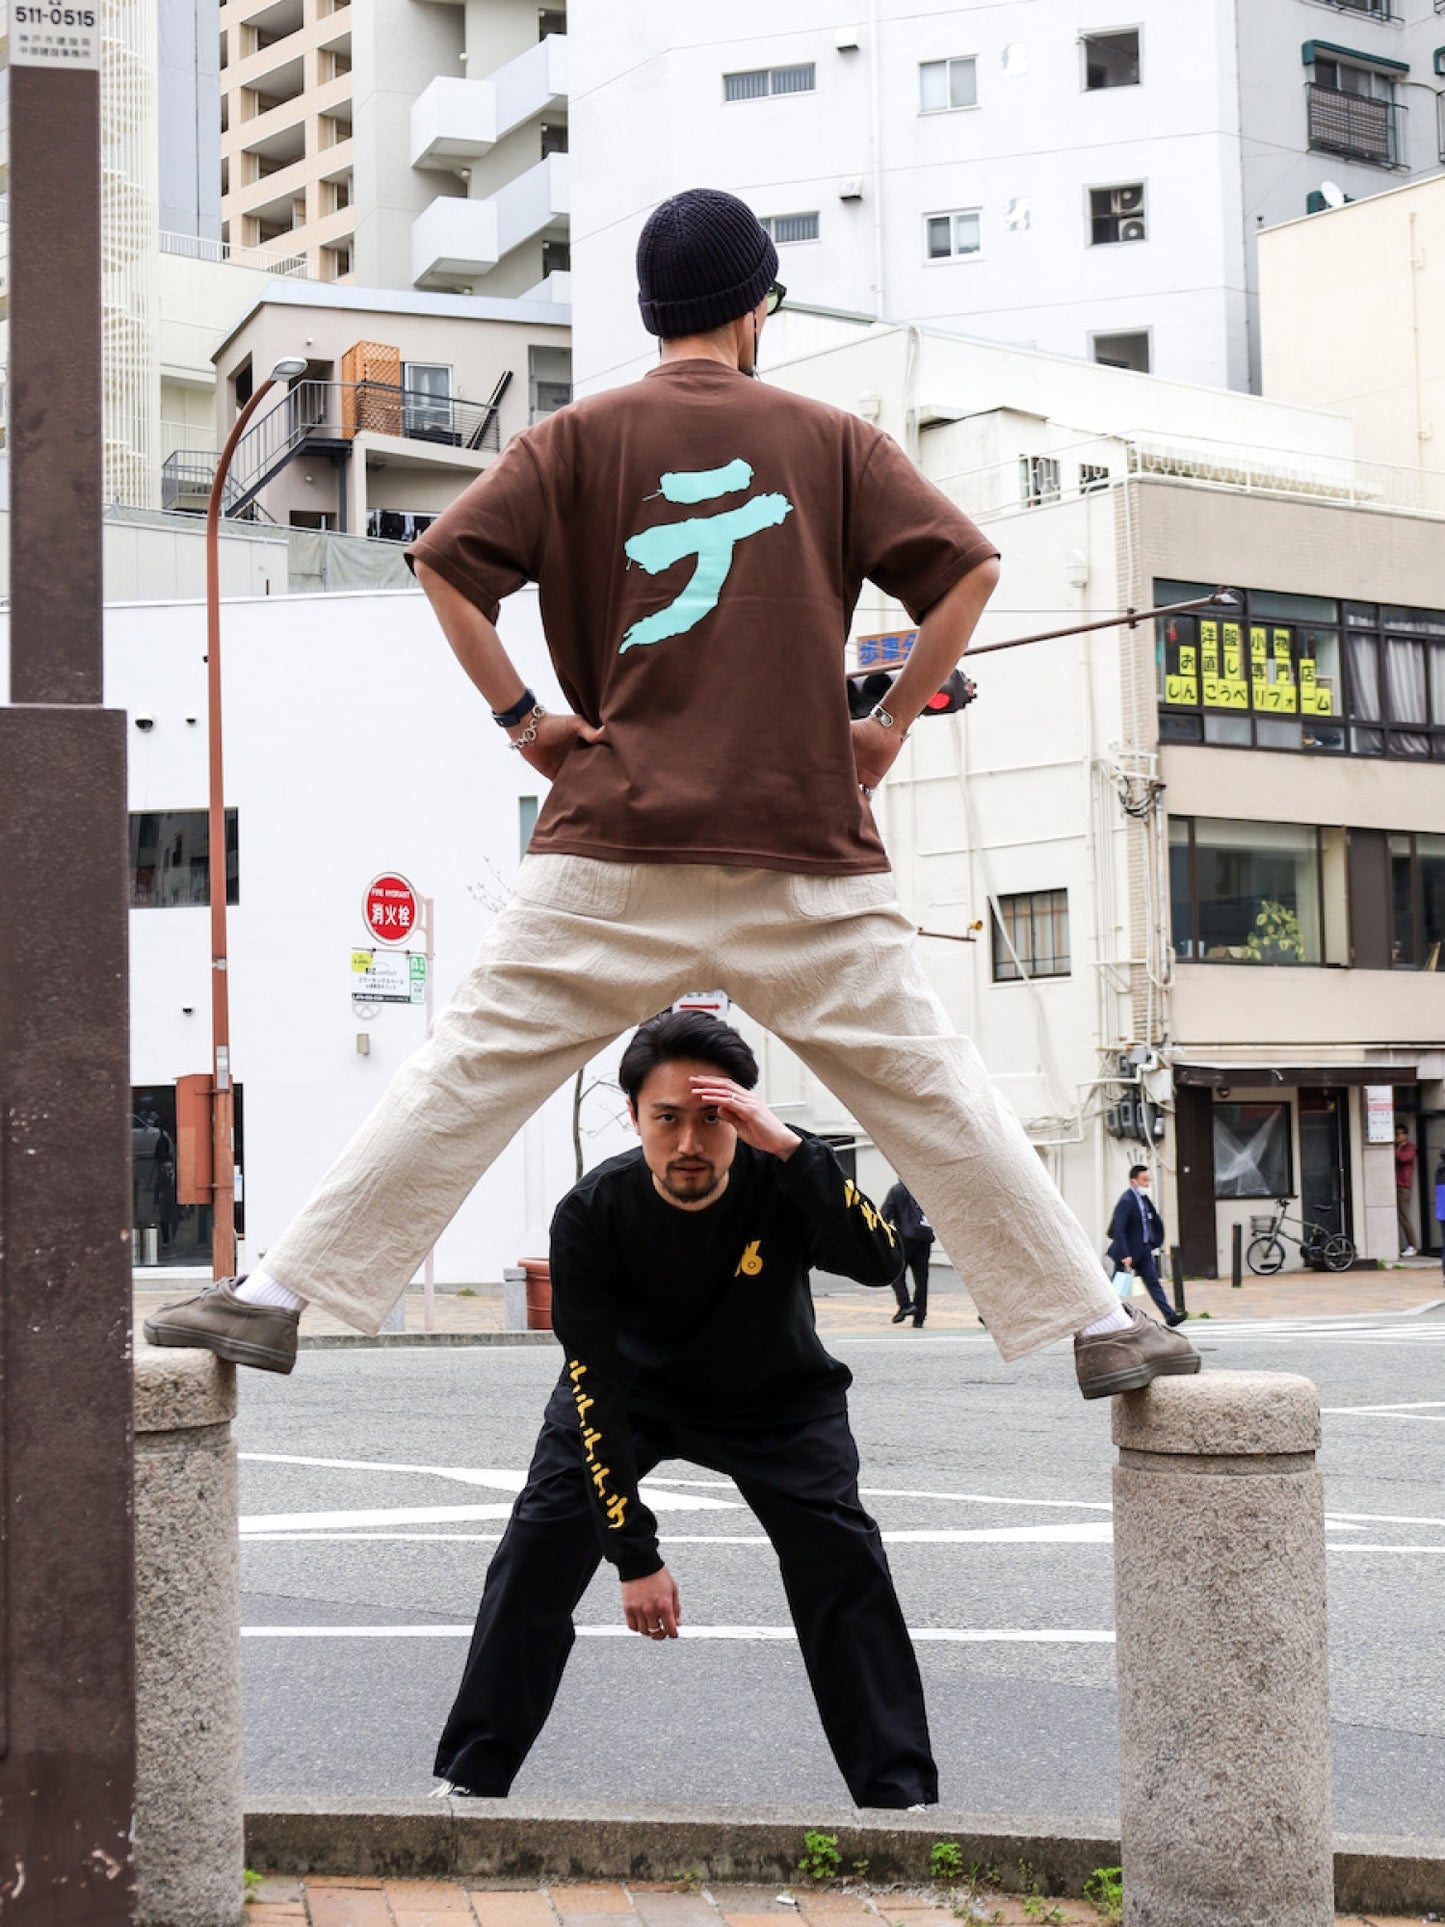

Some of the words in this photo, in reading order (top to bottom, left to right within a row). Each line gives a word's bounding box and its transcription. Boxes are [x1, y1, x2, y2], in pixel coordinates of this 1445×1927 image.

[15, 6, 95, 27] 511-0515
[1201, 626, 1290, 651] 洋服小物
[1180, 653, 1314, 683] お直し専門店
[372, 903, 410, 926] 消火栓
